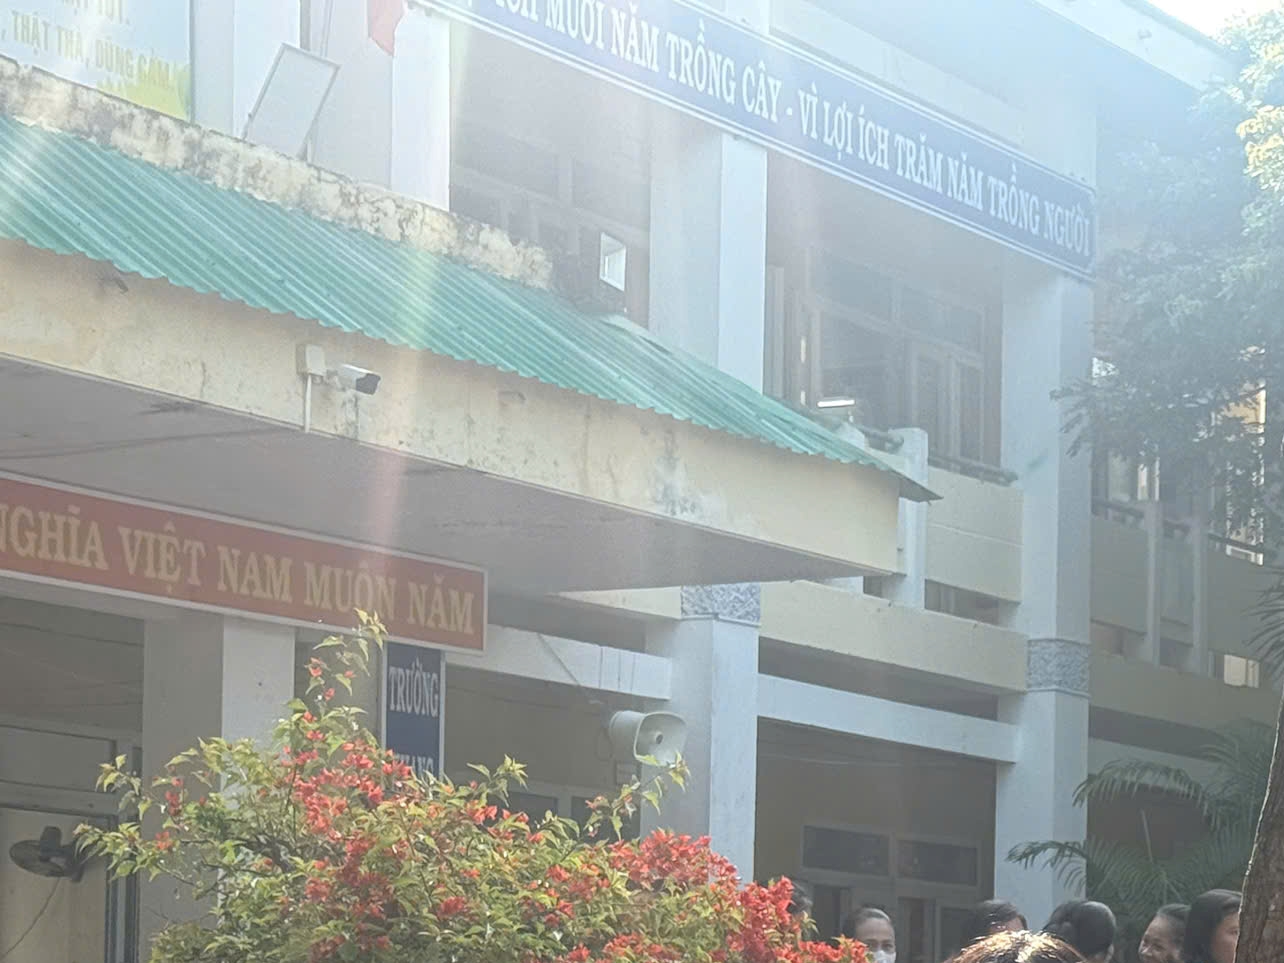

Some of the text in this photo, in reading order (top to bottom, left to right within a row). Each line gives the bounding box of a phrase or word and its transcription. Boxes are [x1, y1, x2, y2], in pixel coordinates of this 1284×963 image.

[610, 4, 660, 73] NĂM
[665, 18, 736, 105] TRỒNG
[742, 62, 782, 123] CÂY
[798, 82, 818, 140] VÌ
[822, 99, 854, 161] LỢI
[856, 105, 889, 171] ÍCH
[894, 132, 943, 193] TRĂM
[987, 161, 1040, 236] TRỒNG
[1044, 199, 1090, 257] NGƯỜI
[119, 521, 207, 594] VIỆT
[216, 544, 293, 604] NAM
[303, 556, 397, 621] MUÔN
[406, 569, 476, 635] NĂM
[388, 656, 440, 718] TRƯỜNG
